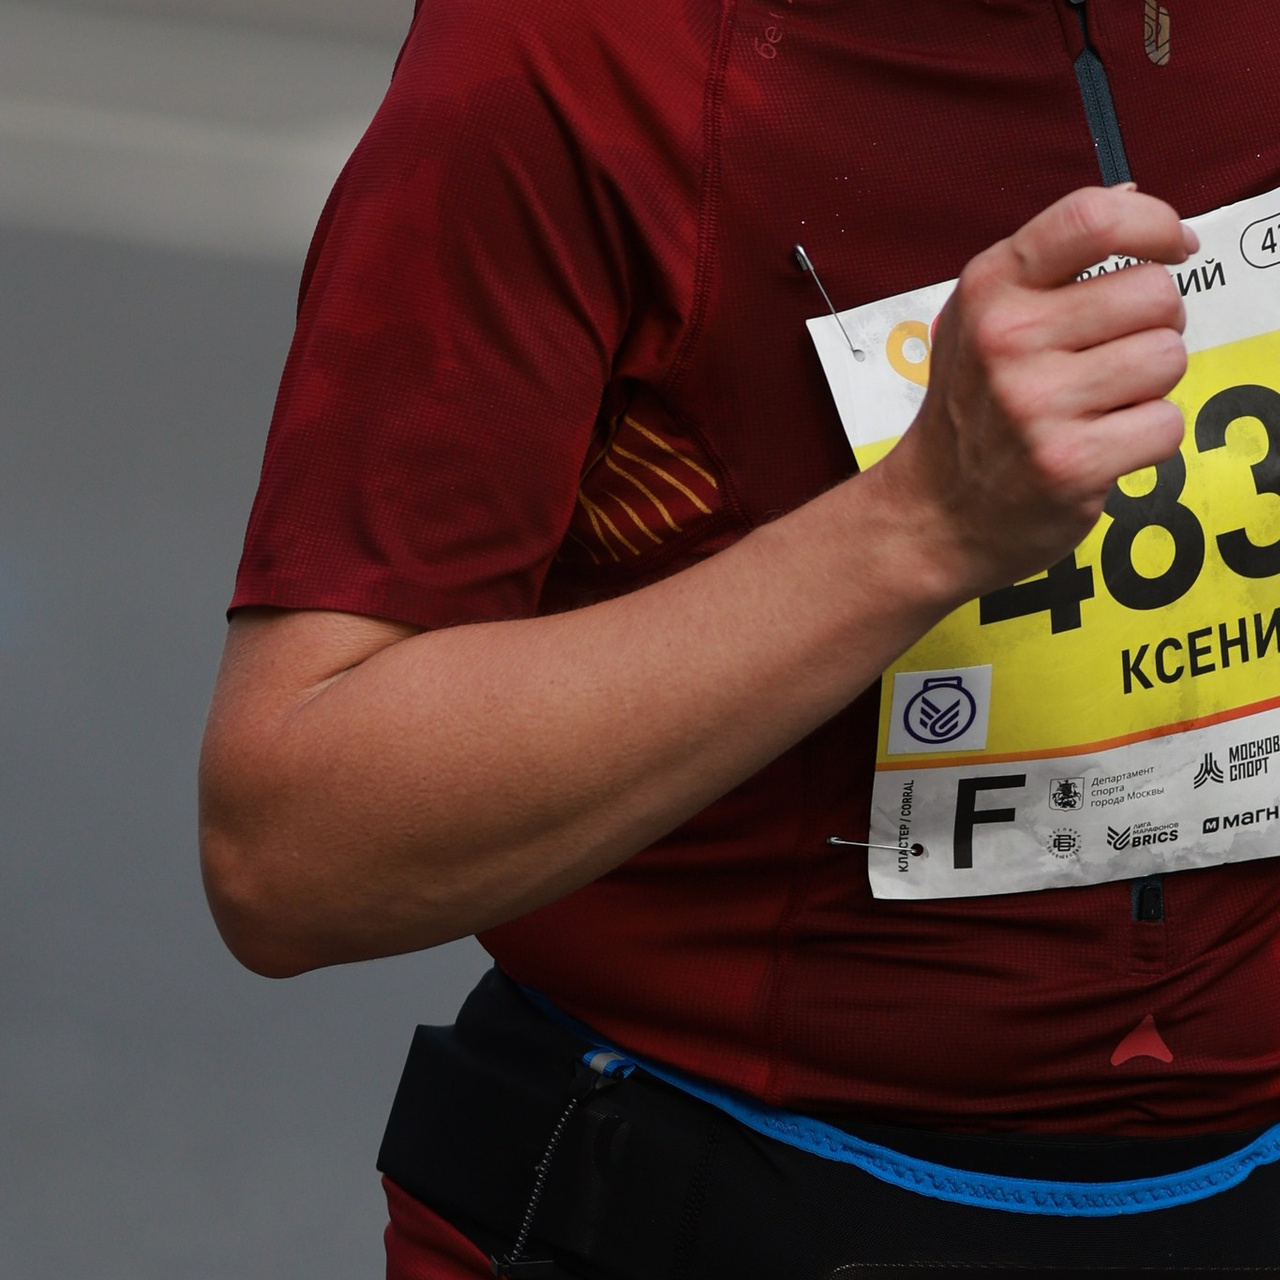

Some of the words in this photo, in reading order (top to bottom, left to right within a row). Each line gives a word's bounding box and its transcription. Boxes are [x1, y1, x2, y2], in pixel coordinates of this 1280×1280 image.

[1090, 766, 1155, 788] Департамент
[1229, 756, 1270, 782] СПОРТ
[900, 779, 915, 817] CORRAL
[1090, 784, 1125, 797] спорта
[1090, 795, 1125, 809] города
[1127, 787, 1165, 801] Москвы
[953, 773, 1027, 870] F
[1132, 822, 1180, 835] МАРАФОНОВ
[1133, 821, 1152, 830] ЛИГА
[898, 824, 910, 873] КЛАСТЕР
[1131, 829, 1179, 848] BRICS
